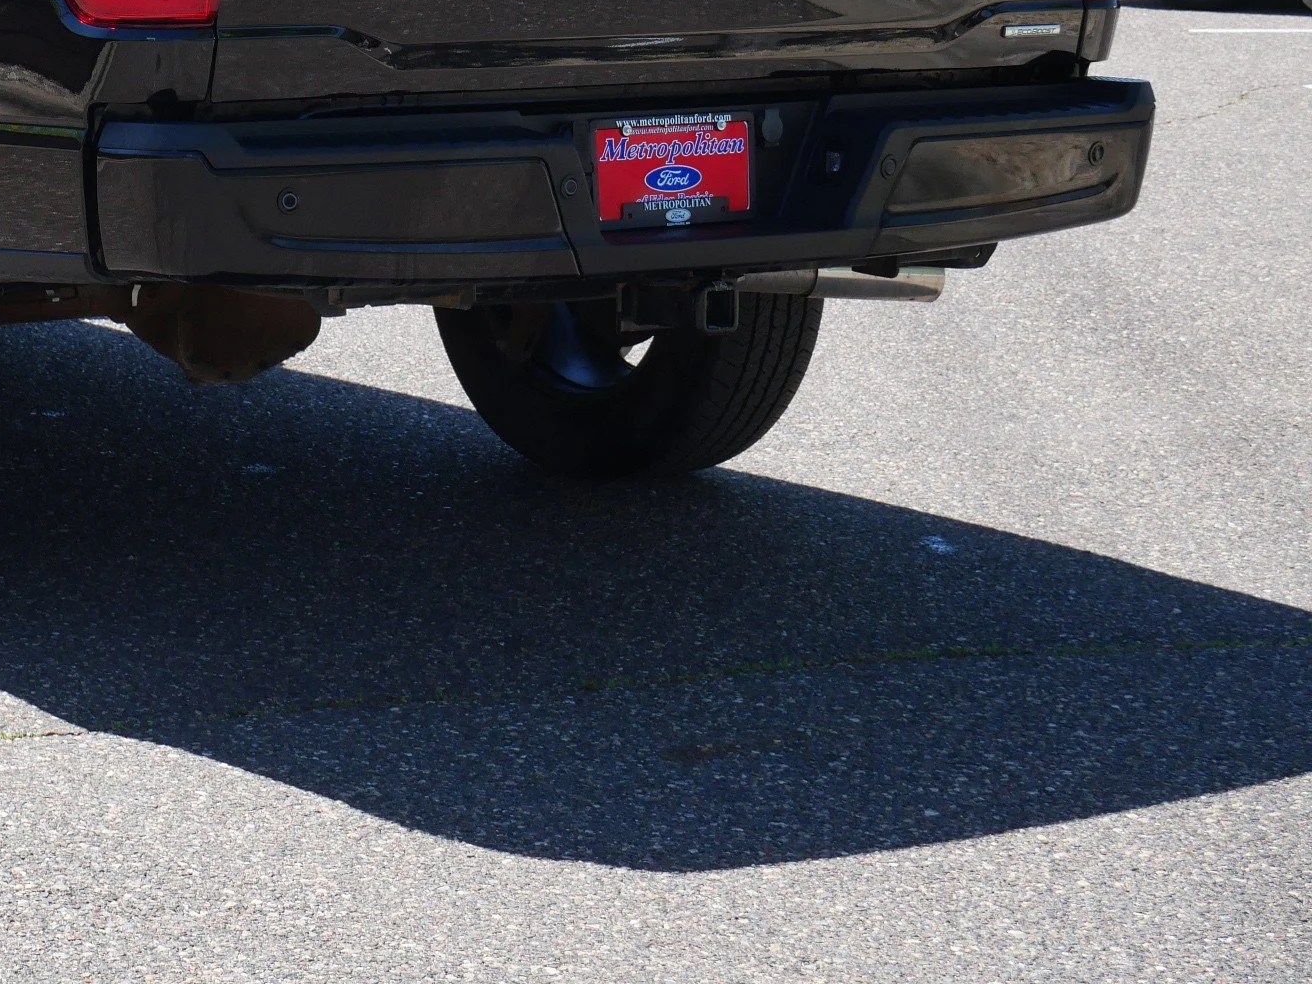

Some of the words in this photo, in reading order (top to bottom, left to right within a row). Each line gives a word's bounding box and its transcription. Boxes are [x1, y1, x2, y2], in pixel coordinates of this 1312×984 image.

[616, 113, 732, 128] www.metropolitanford.com
[600, 132, 745, 165] Metropolitan
[656, 169, 690, 187] Ford
[644, 197, 712, 211] METROPOLITAN
